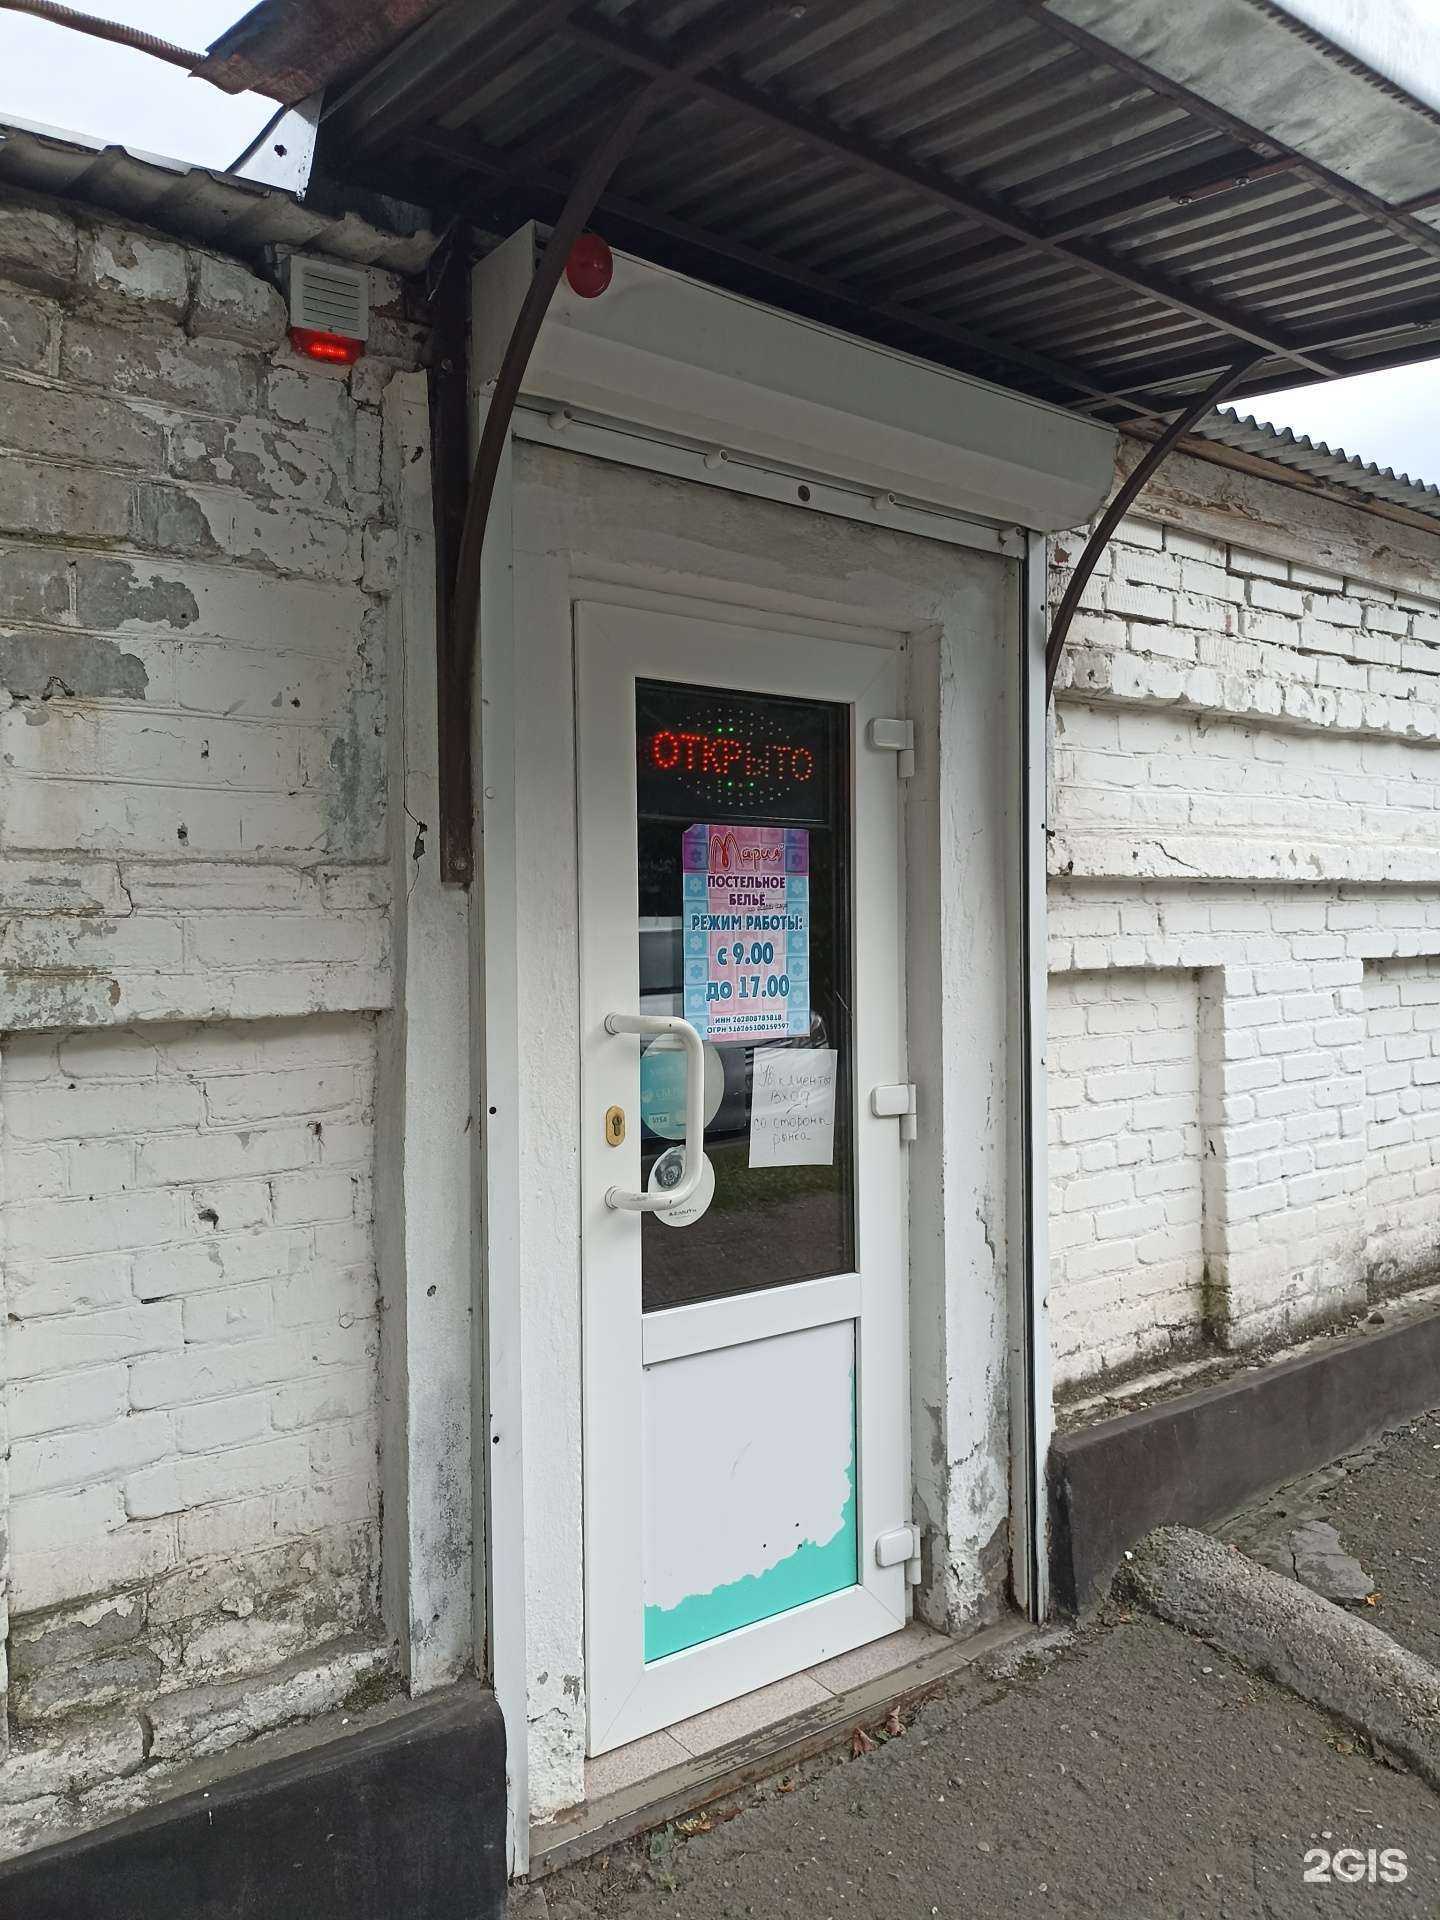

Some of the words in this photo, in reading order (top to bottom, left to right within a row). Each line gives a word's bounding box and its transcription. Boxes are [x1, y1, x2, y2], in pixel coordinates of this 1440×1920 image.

[654, 730, 813, 782] ОТКРЫТО
[707, 875, 786, 889] ПОСТЕЛЬНОЕ
[691, 914, 742, 931] РЕЖИМ
[745, 914, 803, 931] РАБОТЫ:
[732, 942, 774, 965] 9.00
[738, 975, 790, 998] 17.00
[715, 1016, 731, 1024] ИНН
[706, 1024, 727, 1034] ОГРН
